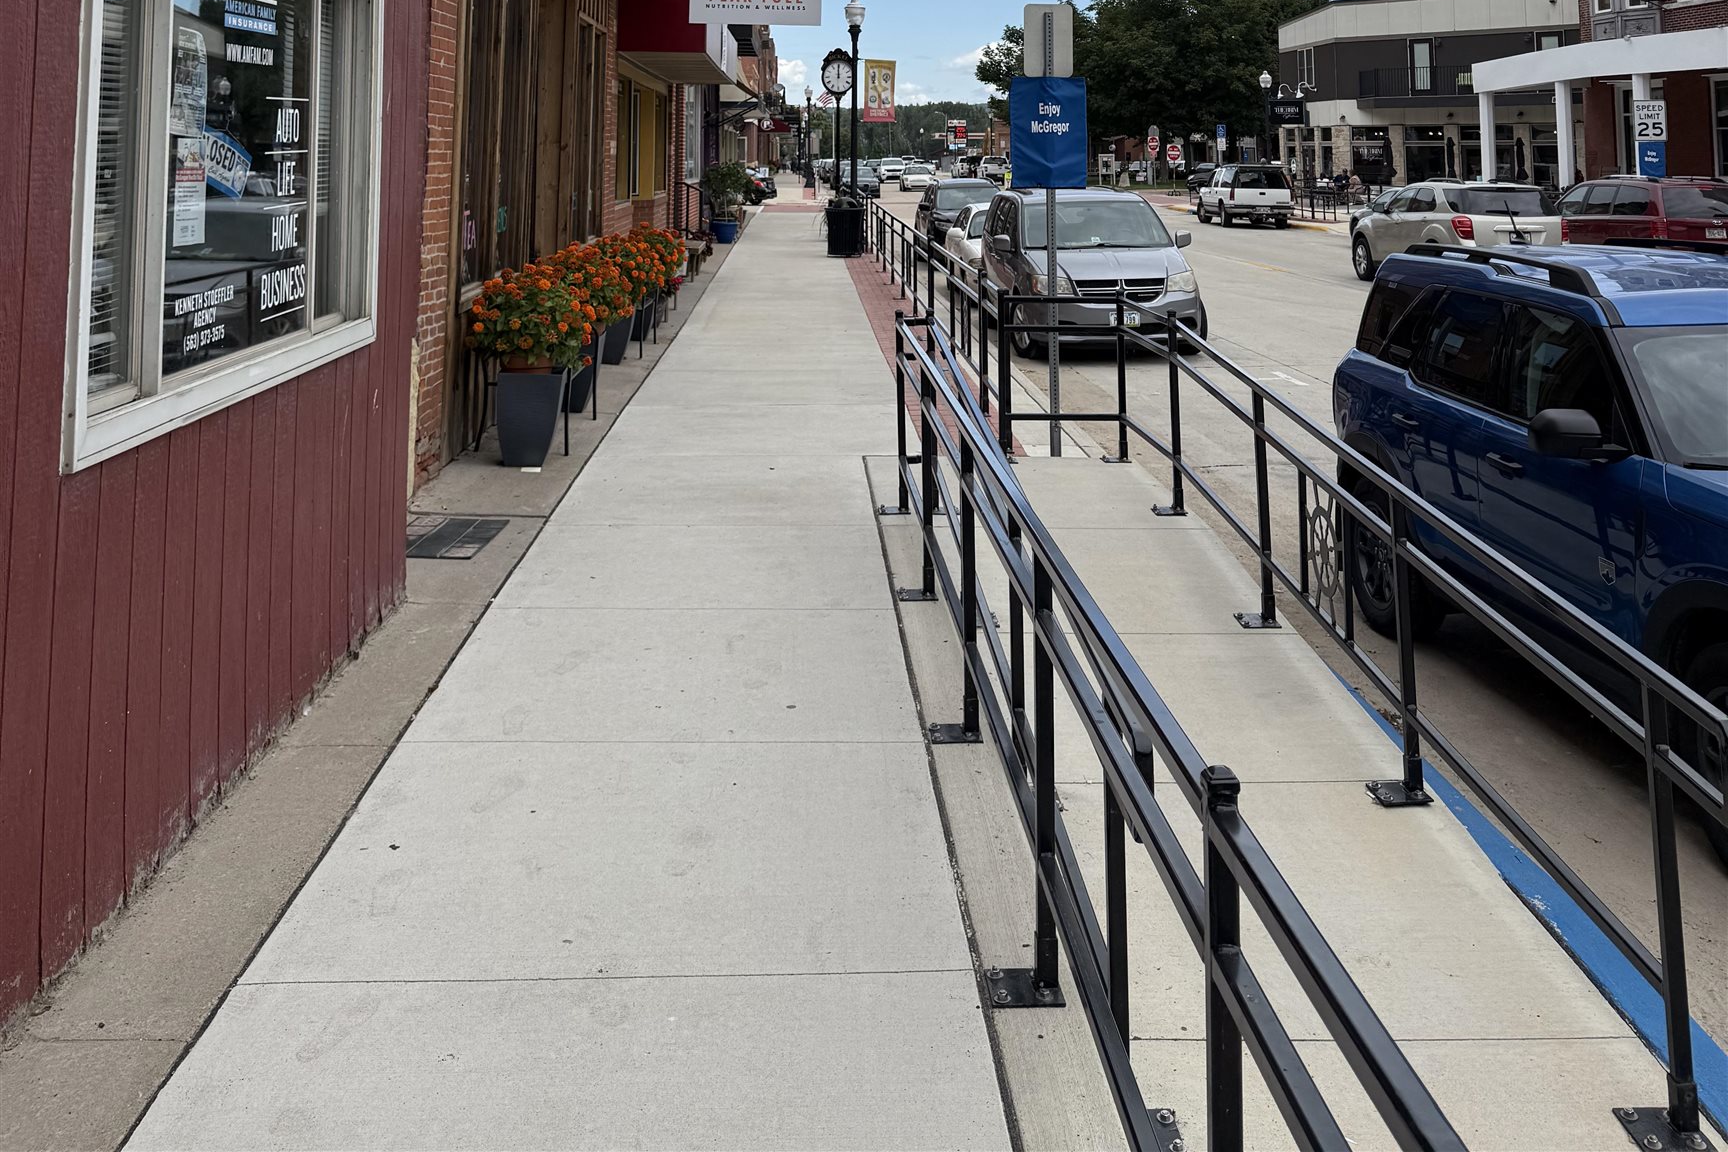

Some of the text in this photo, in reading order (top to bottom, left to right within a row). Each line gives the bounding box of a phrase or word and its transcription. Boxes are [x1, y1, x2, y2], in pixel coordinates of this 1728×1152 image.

[228, 16, 273, 32] INSURANCE
[256, 5, 277, 21] FAMILY
[226, 43, 274, 66] WWW.AMFAM.COM
[1038, 102, 1061, 118] Enjoy
[1635, 104, 1664, 112] SPEED
[276, 108, 300, 143] AUTO
[1031, 120, 1070, 136] McGregor
[1637, 122, 1664, 137] 25
[203, 134, 236, 173] OSED
[277, 161, 296, 196] LIFE
[272, 213, 299, 252] HOME
[463, 210, 477, 250] TEA
[260, 264, 306, 311] BUSINESS
[175, 284, 234, 317] KENNETH STOEFFLER
[193, 306, 217, 329] AGENCY
[183, 331, 200, 356] (563)
